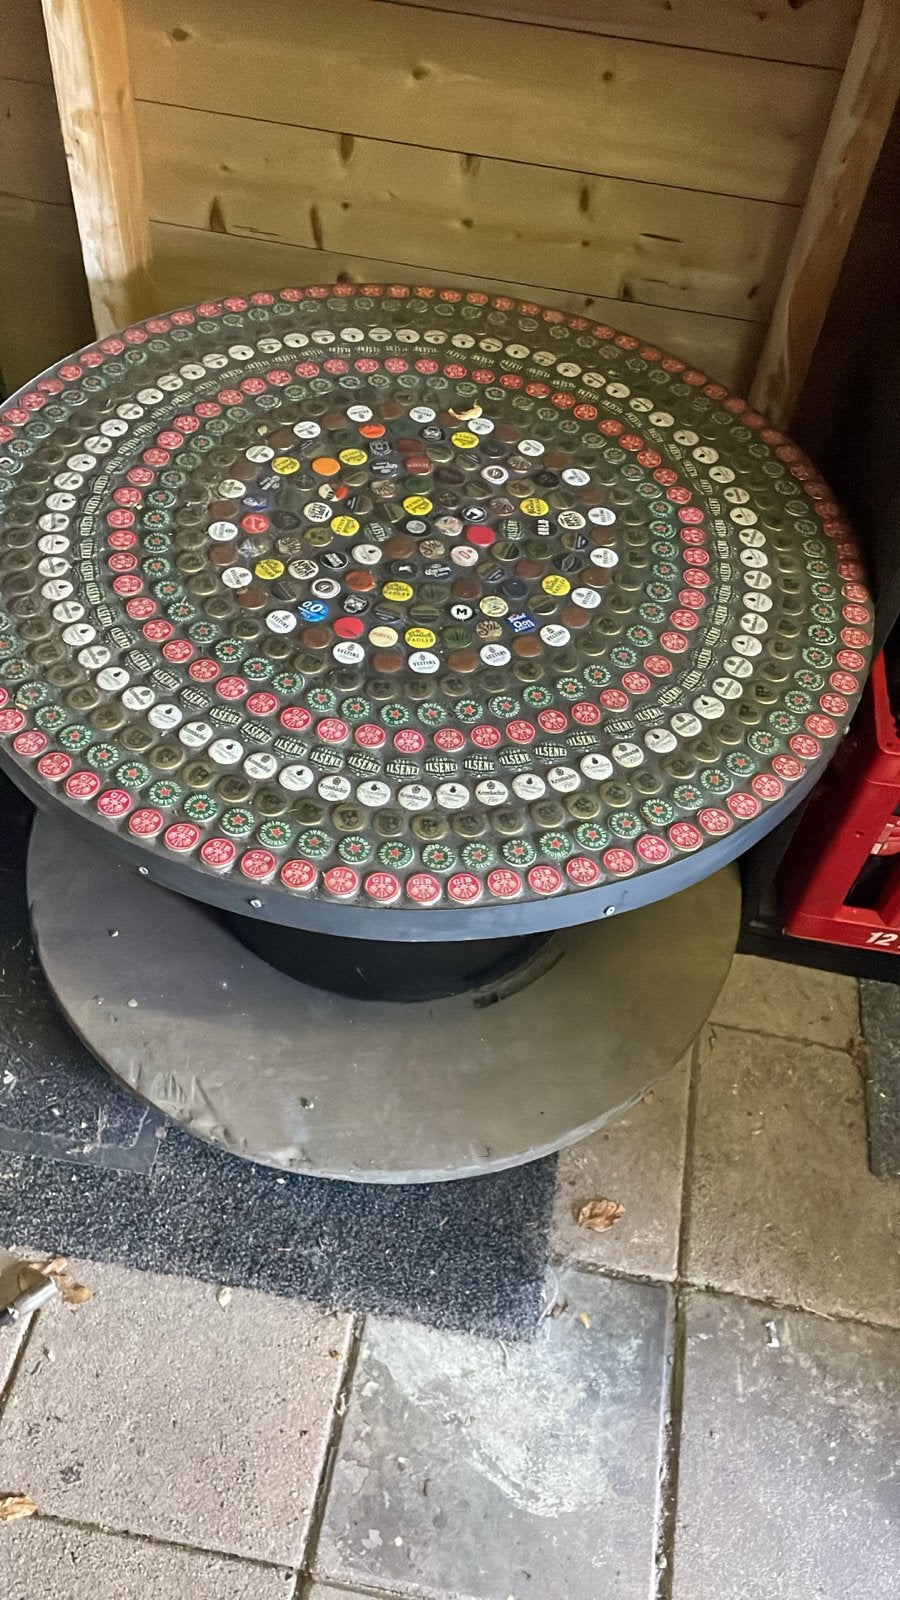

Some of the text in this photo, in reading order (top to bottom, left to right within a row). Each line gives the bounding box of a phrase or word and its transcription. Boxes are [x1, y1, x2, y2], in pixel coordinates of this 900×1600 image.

[97, 604, 113, 627] ILSENE
[271, 614, 290, 629] VELTINS
[714, 605, 728, 625] ILSENE
[110, 627, 131, 649] ILSENE
[546, 629, 566, 641] VELTINS
[705, 627, 721, 646] ILSENE
[129, 649, 152, 671] ILSENE
[337, 647, 359, 659] VELTINS
[485, 650, 507, 660] VELTINS
[697, 648, 712, 669] ILSENE
[152, 668, 180, 690] ILSENE
[681, 670, 702, 690] ILSENE
[180, 688, 210, 708] ILSENE
[657, 686, 683, 706] ILSENE
[209, 708, 242, 725] ILSENE
[635, 706, 665, 721] ILSENE
[242, 722, 272, 744] ILSENE
[604, 720, 635, 734] ILSENE
[273, 739, 307, 757] ILSENE
[566, 735, 600, 746] ILSENE
[310, 751, 344, 768] ILSENE
[499, 753, 532, 765] ILSENE
[534, 746, 567, 757] ILSENE
[348, 756, 381, 773] ILSENE
[386, 764, 420, 775] ILSENE
[425, 762, 458, 773] ILSENE
[464, 760, 495, 771] ILSENE
[320, 783, 347, 793] Krombacher
[400, 792, 428, 800] Krombacher
[261, 821, 292, 838] Heineken
[259, 832, 286, 846] ORIGINAL
[866, 931, 899, 946] 12
